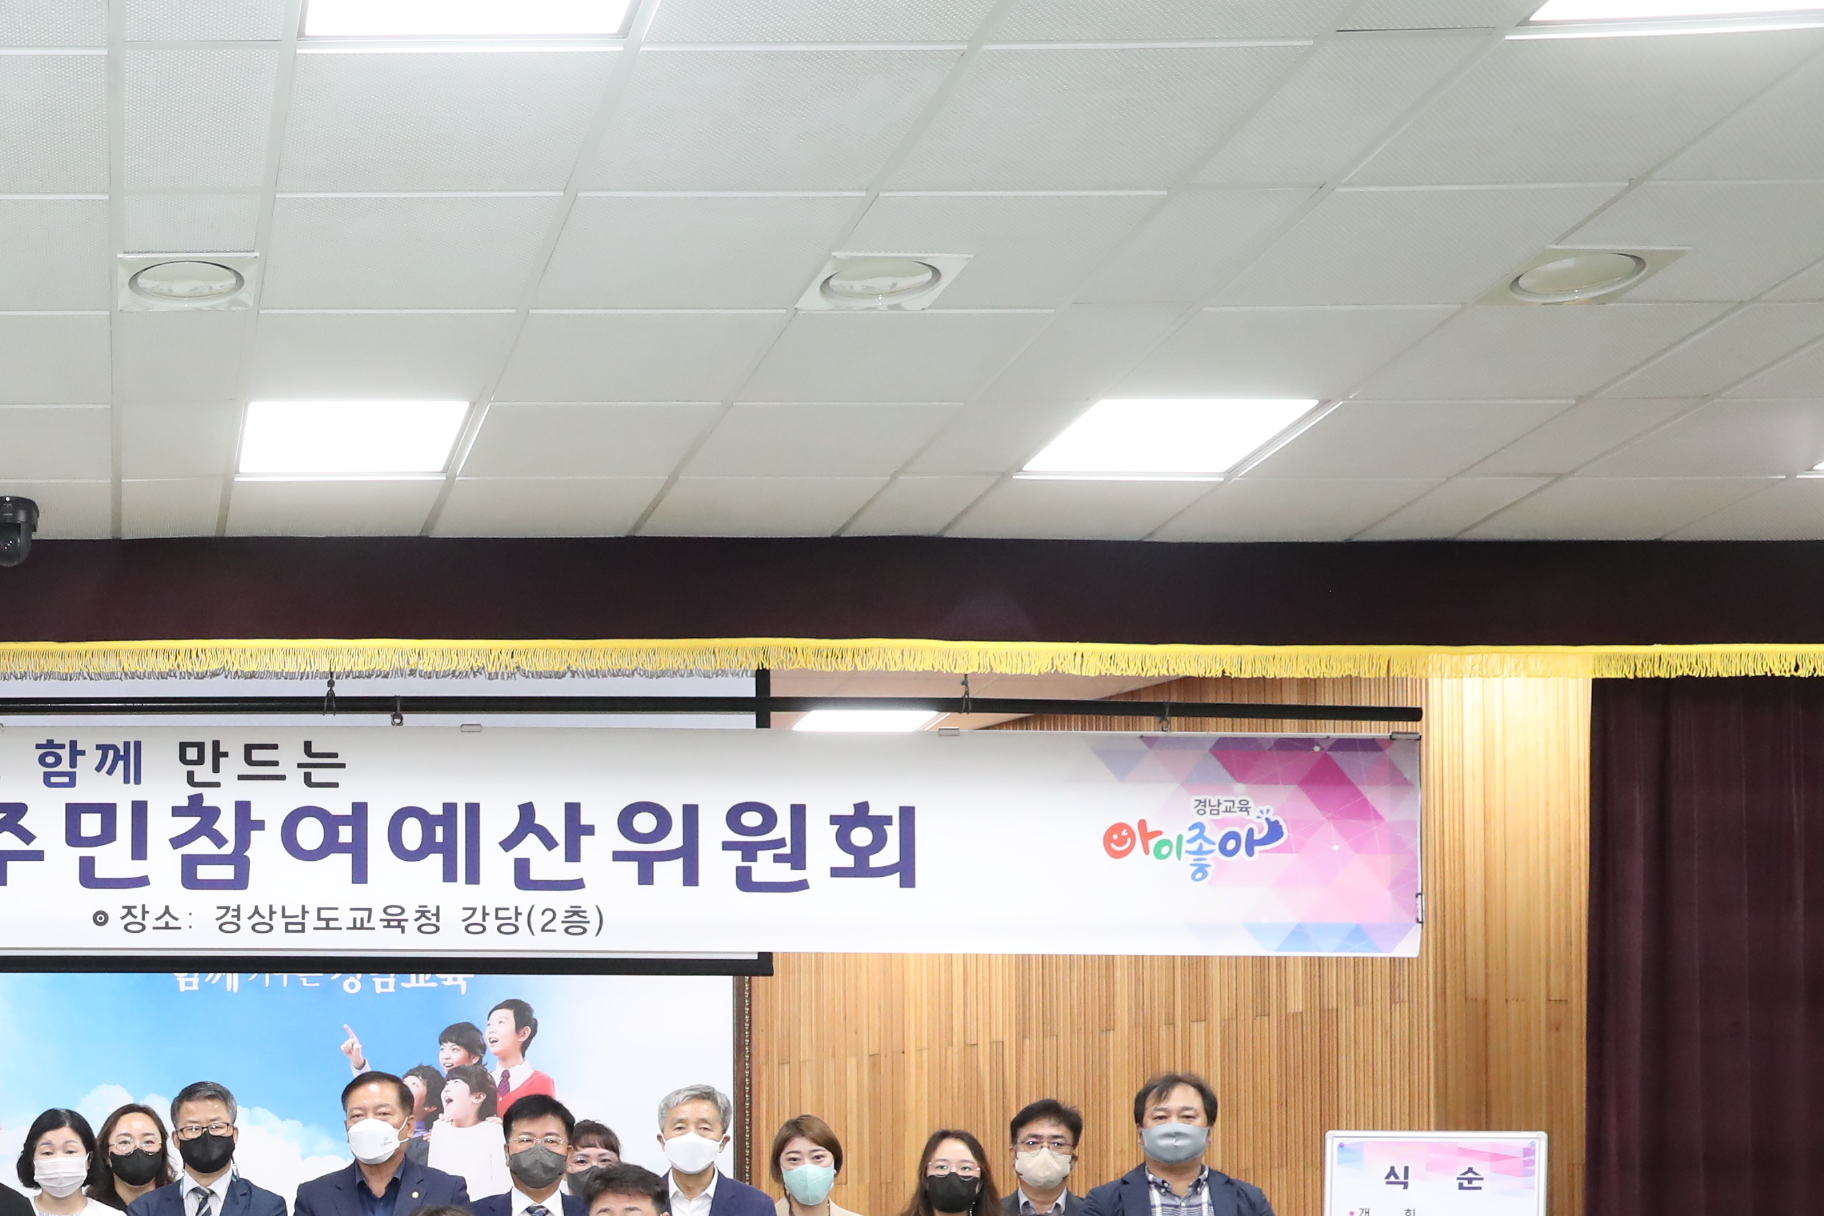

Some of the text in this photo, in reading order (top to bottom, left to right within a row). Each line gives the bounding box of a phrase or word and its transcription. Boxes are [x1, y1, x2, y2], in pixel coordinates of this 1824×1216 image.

[34, 738, 142, 789] 함께
[178, 739, 347, 789] 만드는
[1193, 798, 1252, 816] 경남교육
[1103, 817, 1285, 882] 아이좋아
[119, 903, 604, 937] 장소: 경상남도교육청 강당(2층)
[1384, 1165, 1485, 1191] 식 순
